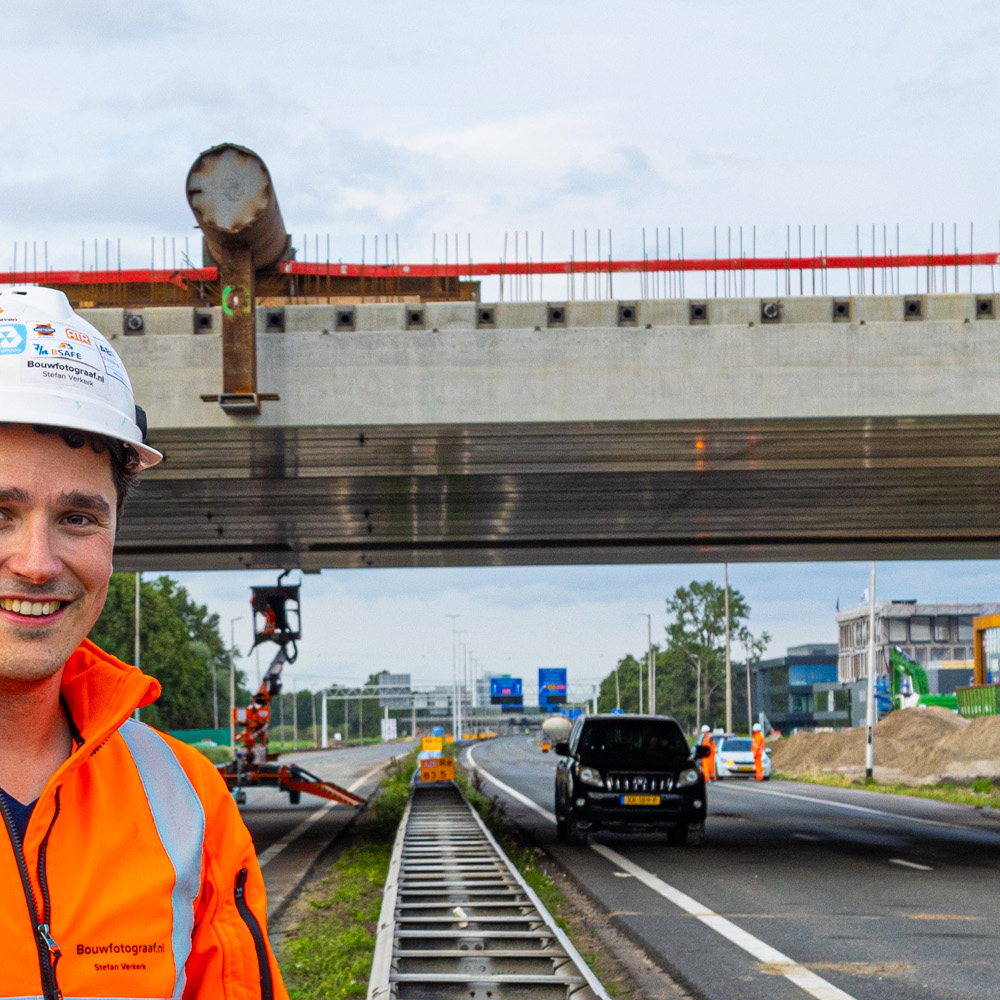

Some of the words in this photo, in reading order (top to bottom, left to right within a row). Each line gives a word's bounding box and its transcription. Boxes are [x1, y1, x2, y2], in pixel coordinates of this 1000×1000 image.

[51, 349, 82, 359] BSAFE
[27, 360, 105, 383] Bouwfotograaf.nl
[42, 370, 66, 380] Stefan
[68, 372, 94, 386] Verkerk
[76, 942, 165, 956] Bouwfotograaf.nl
[94, 963, 119, 971] Stefan
